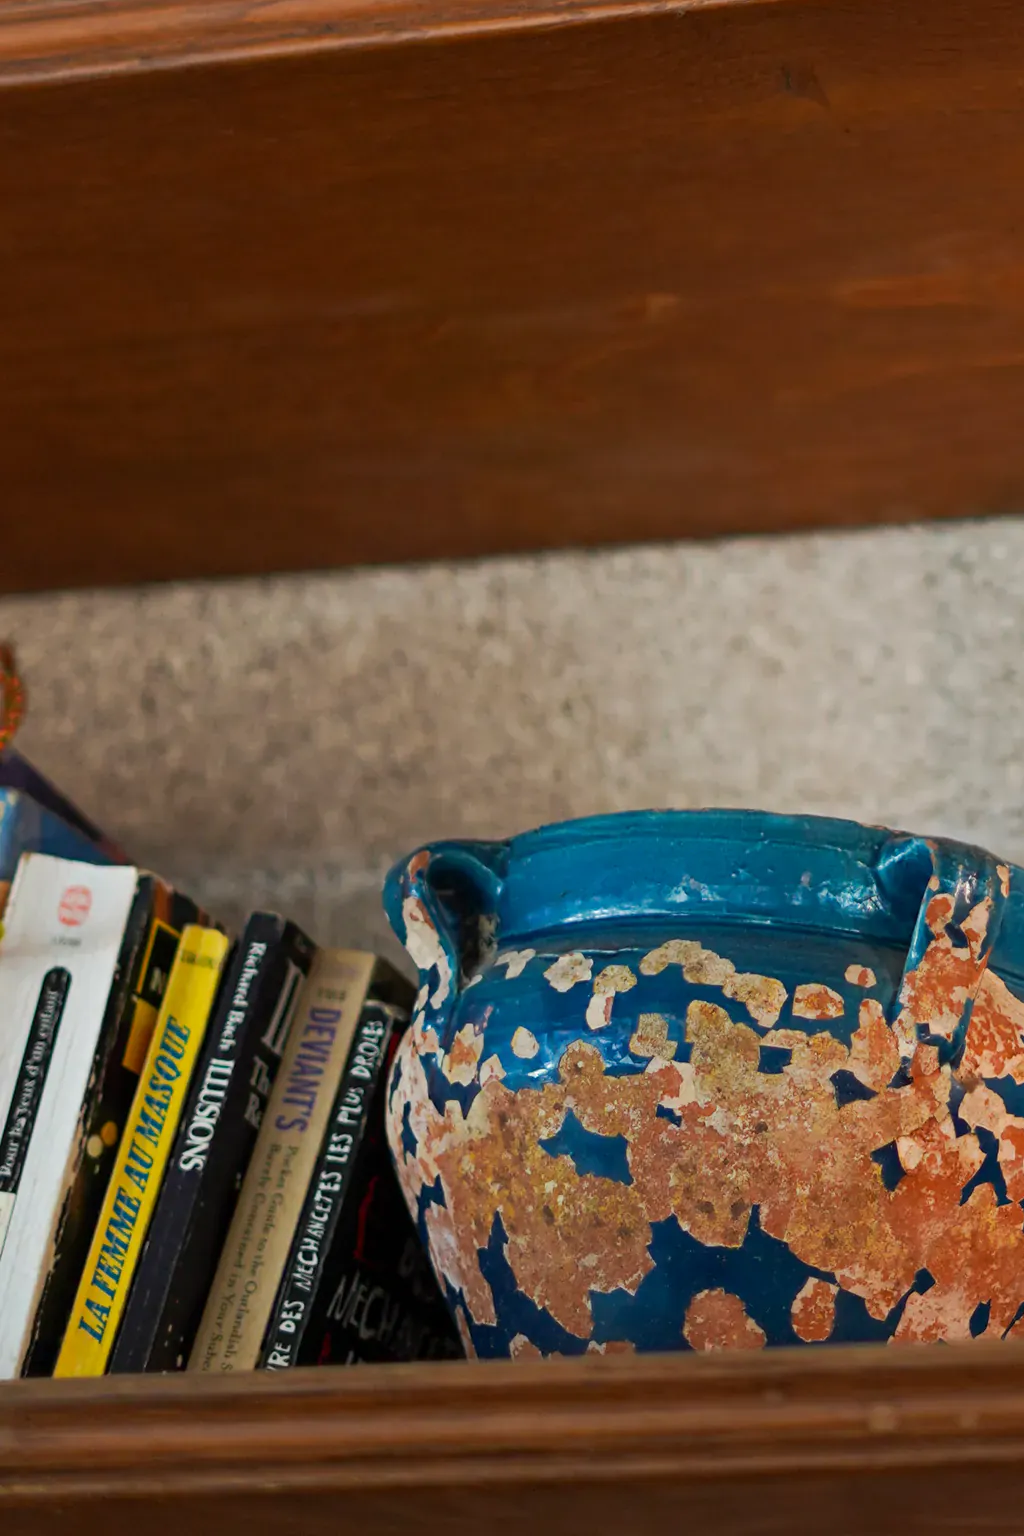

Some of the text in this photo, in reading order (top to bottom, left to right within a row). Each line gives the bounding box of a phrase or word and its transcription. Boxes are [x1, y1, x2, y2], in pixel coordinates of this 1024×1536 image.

[179, 941, 268, 1172] Richard Bach ILLUSIONS
[273, 1006, 343, 1134] DEVIANT'S
[349, 1019, 385, 1080] DROLES
[335, 1086, 365, 1125] PLUS
[77, 1014, 191, 1344] LA FEMME AU MASQUE
[324, 1132, 354, 1164] LES
[291, 1170, 343, 1292] MECHANCETES
[224, 1279, 259, 1359] Outlandish
[279, 1300, 306, 1334] DES
